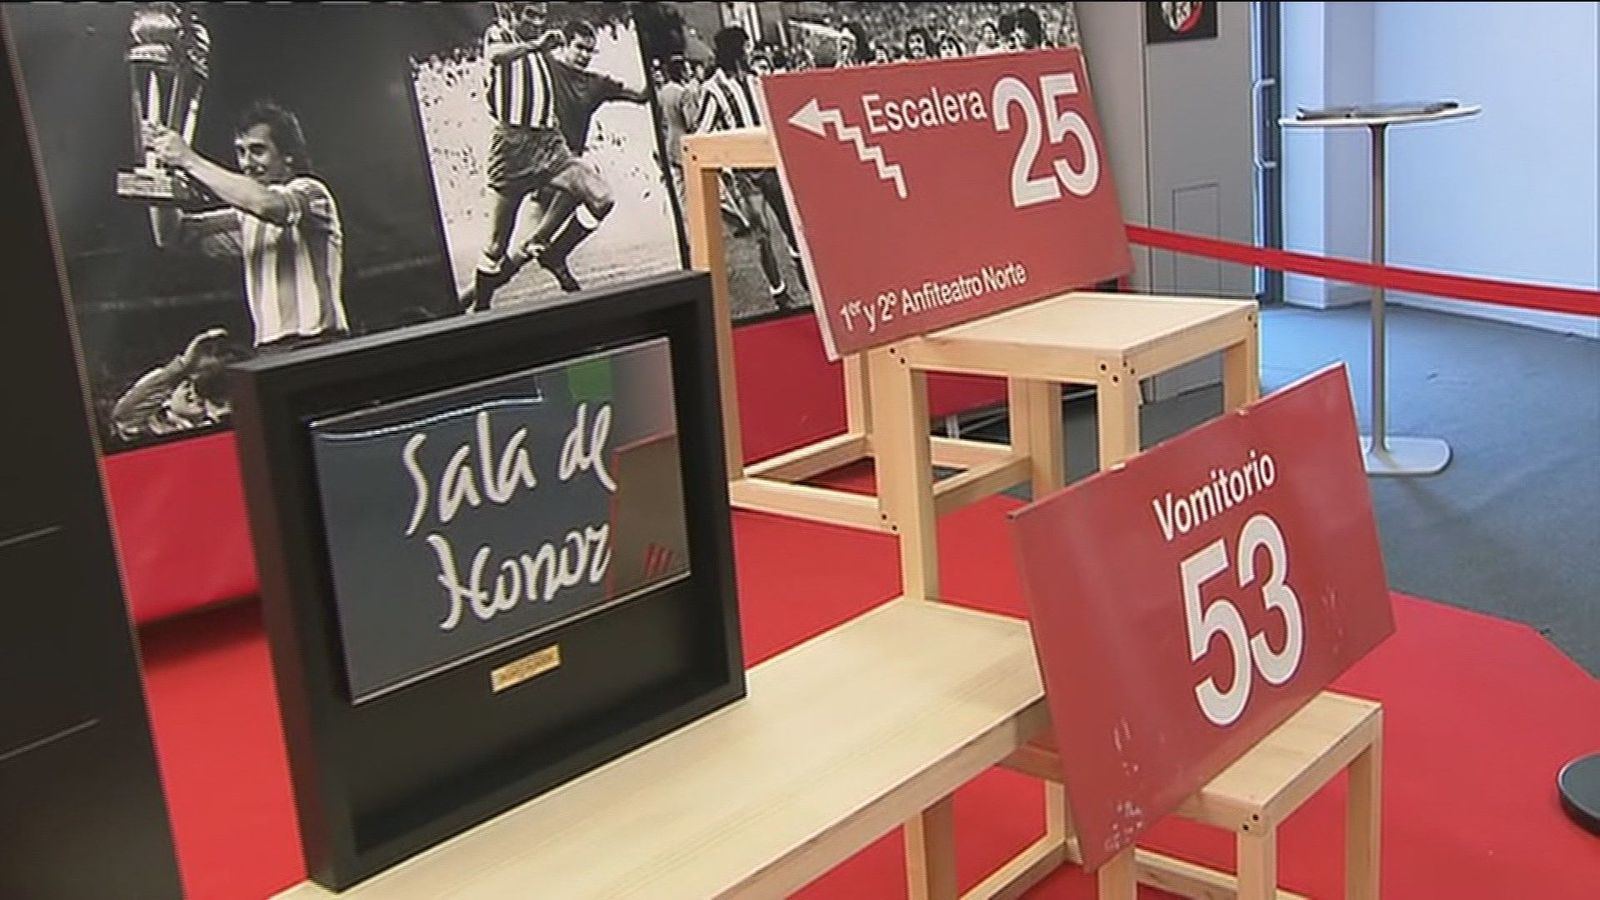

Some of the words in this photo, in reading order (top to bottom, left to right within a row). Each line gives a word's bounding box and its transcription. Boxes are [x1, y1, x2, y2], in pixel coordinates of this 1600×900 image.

[861, 87, 988, 135] Escalera
[992, 72, 1099, 208] 25
[862, 303, 877, 333] y
[901, 275, 983, 316] Anfiteatro
[981, 261, 1027, 294] Norte
[402, 410, 538, 536] Sala
[558, 402, 616, 491] de
[1152, 449, 1278, 541] Vomitorio
[426, 523, 612, 630] Honor
[1180, 513, 1306, 726] 53
